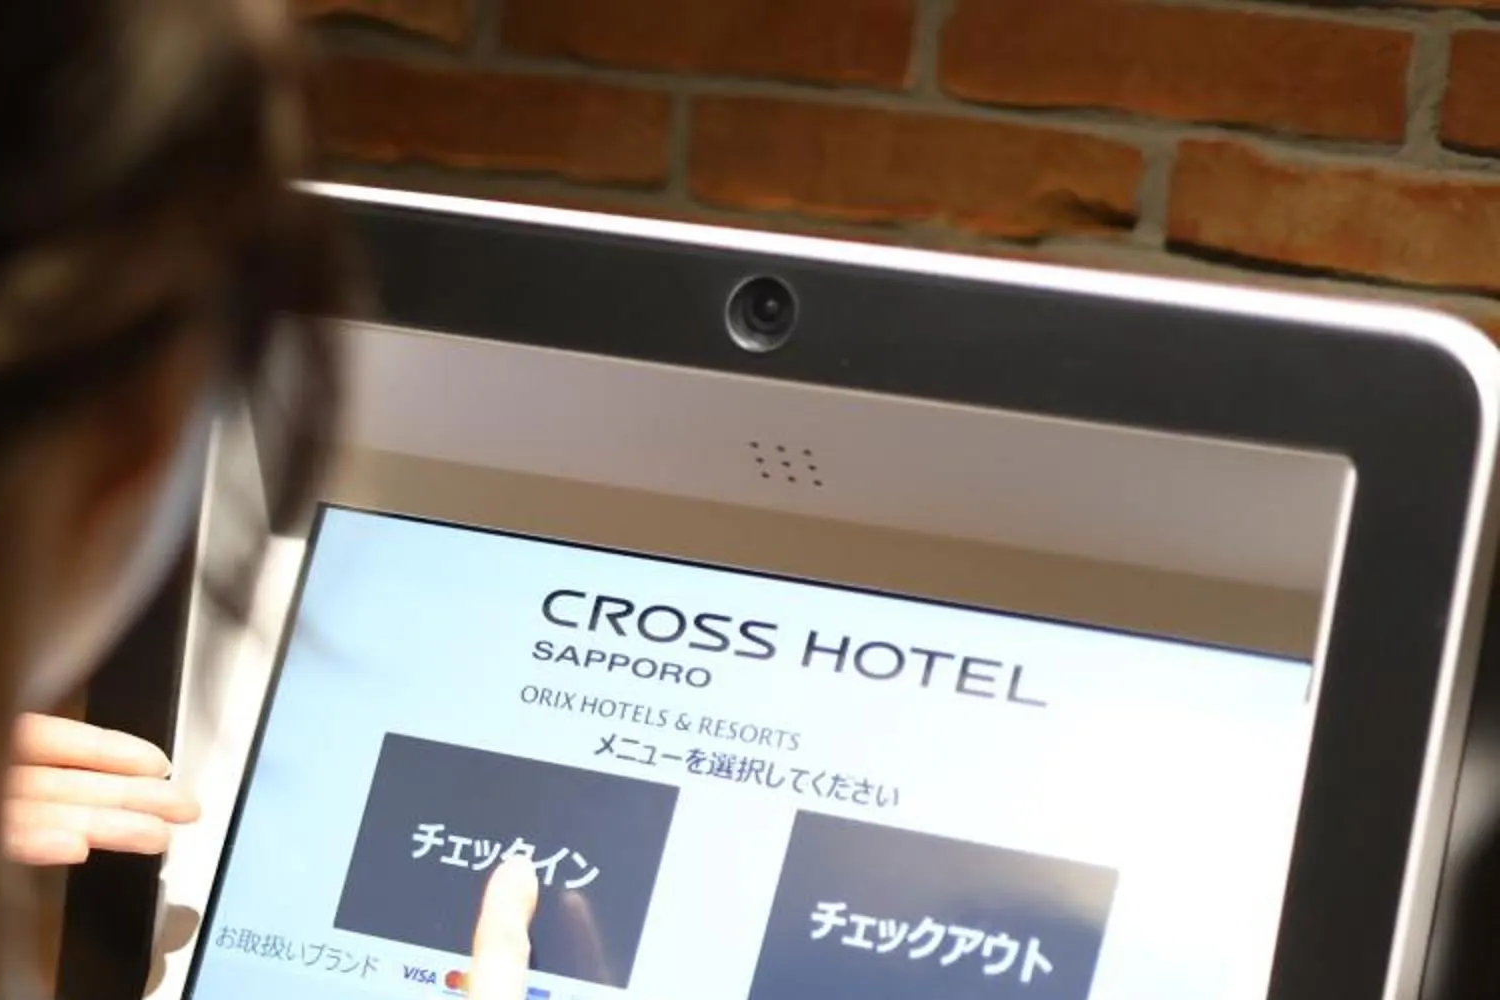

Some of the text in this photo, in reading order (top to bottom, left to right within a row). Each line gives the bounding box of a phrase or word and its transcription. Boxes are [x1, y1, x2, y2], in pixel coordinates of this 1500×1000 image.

[532, 640, 712, 687] SAPPORO
[542, 589, 1047, 708] CROSS HOTEL
[520, 685, 801, 751] ORIX HOTELS & RESORTS
[594, 733, 900, 807] メニューを選択してください
[215, 925, 380, 979] お取扱いブランド
[402, 964, 437, 985] VISA
[810, 901, 1053, 983] チェックアウト
